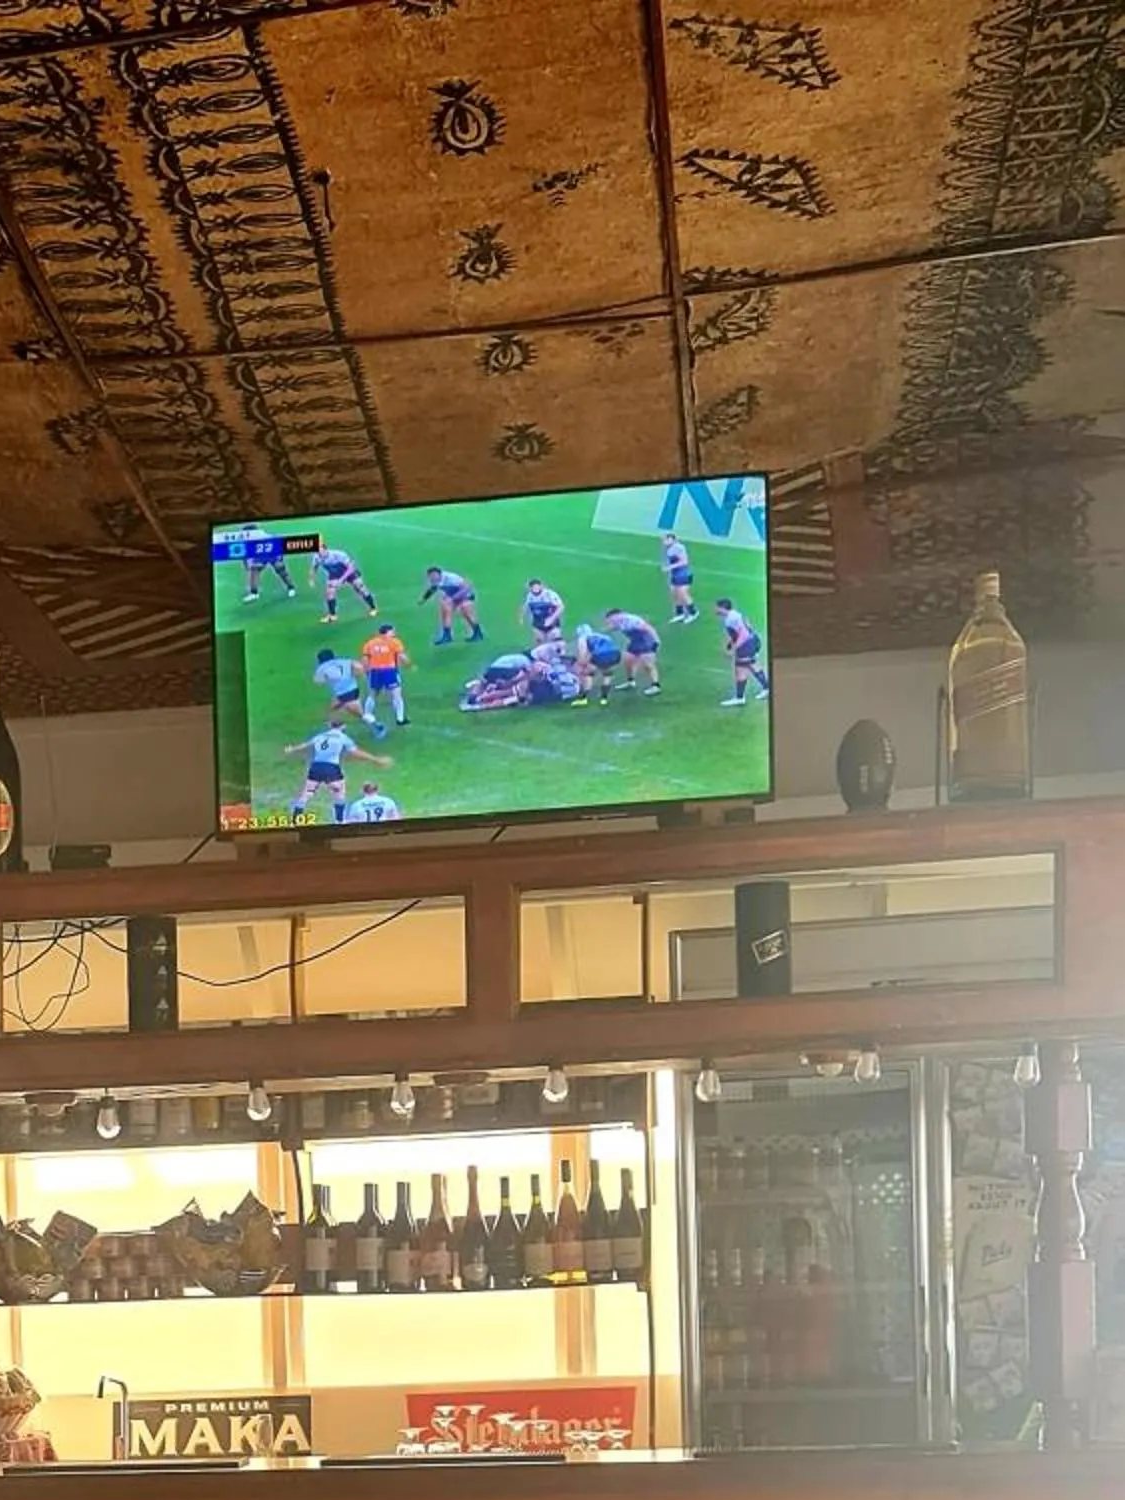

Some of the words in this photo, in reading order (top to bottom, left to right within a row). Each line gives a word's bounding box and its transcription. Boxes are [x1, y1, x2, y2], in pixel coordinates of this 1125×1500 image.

[320, 740, 330, 751] 6
[164, 1400, 270, 1413] PREMIUM
[129, 1413, 312, 1457] MAKA
